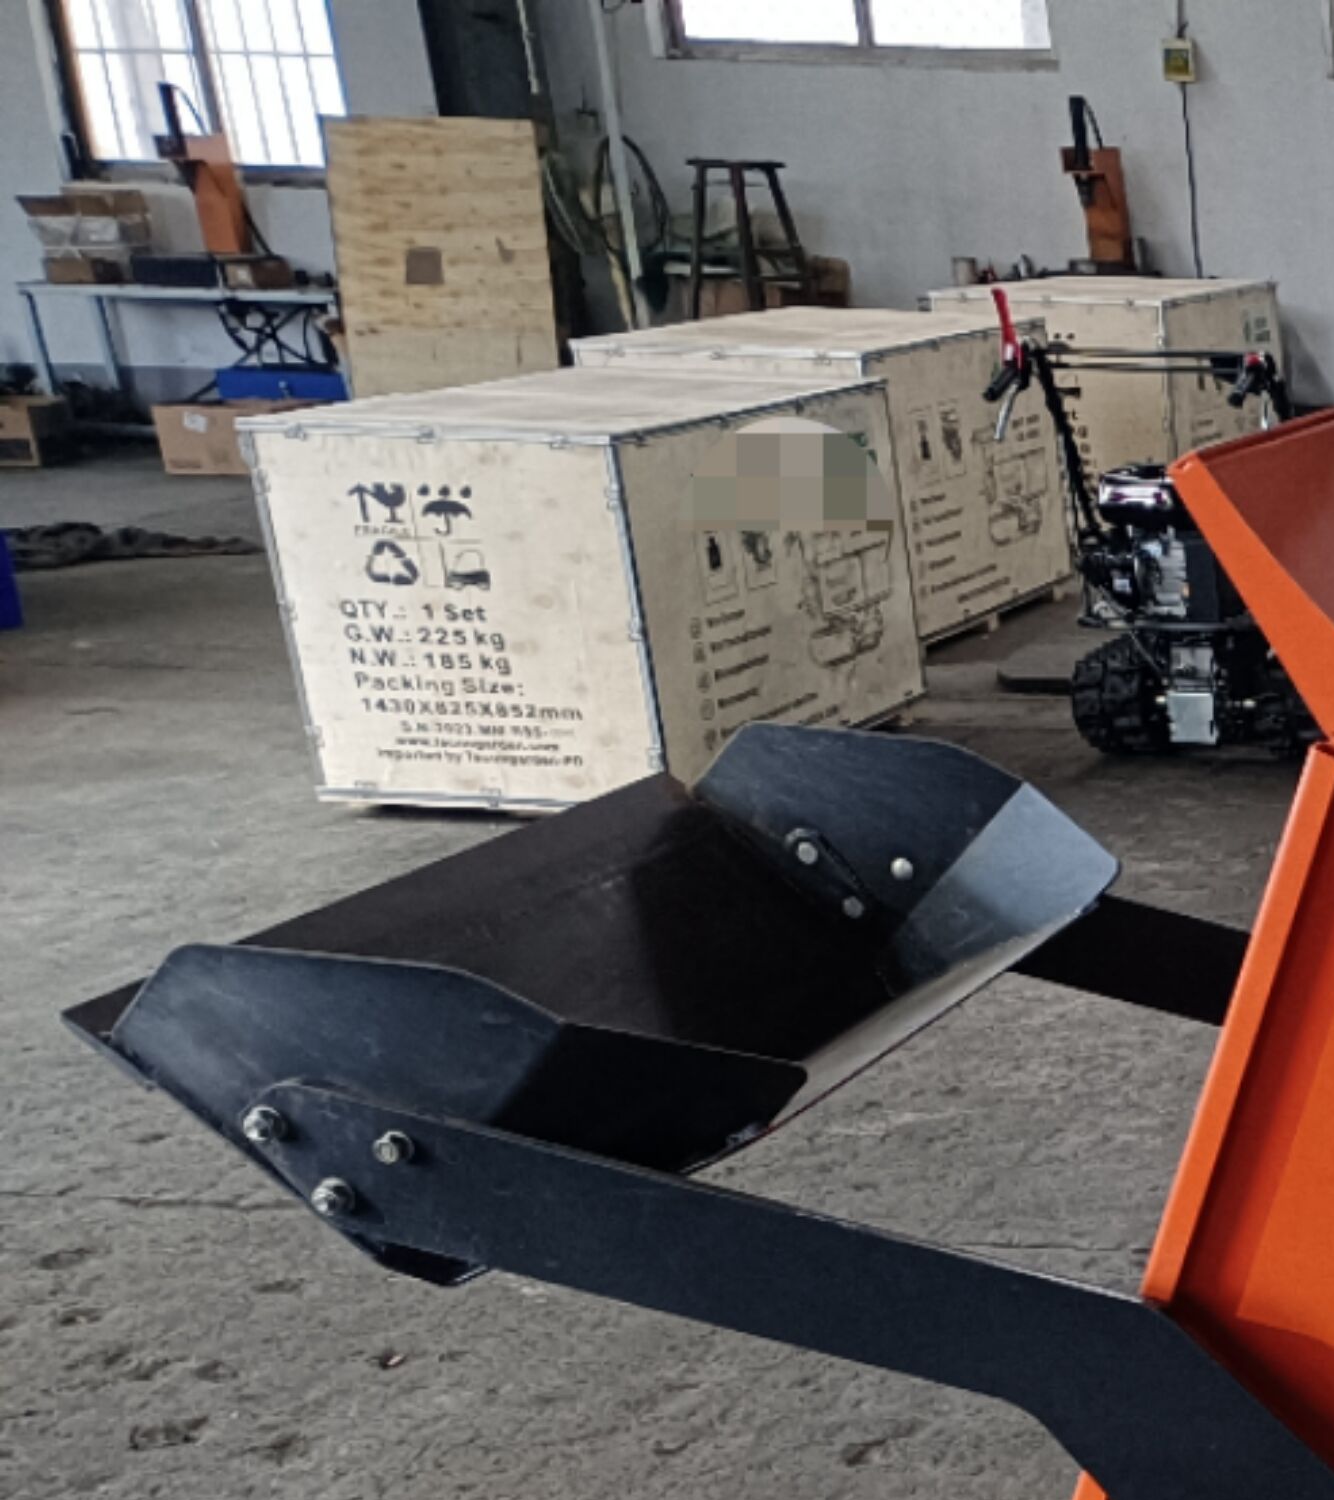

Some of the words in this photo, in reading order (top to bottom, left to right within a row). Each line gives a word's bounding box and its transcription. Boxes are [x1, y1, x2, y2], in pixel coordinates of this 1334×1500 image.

[422, 603, 434, 619] 1
[444, 604, 487, 622] Set
[417, 627, 467, 646] 225
[473, 629, 505, 652] kg
[423, 652, 472, 670] 185
[479, 654, 511, 677] kg
[354, 671, 455, 697] Packing
[461, 676, 525, 697] Size:
